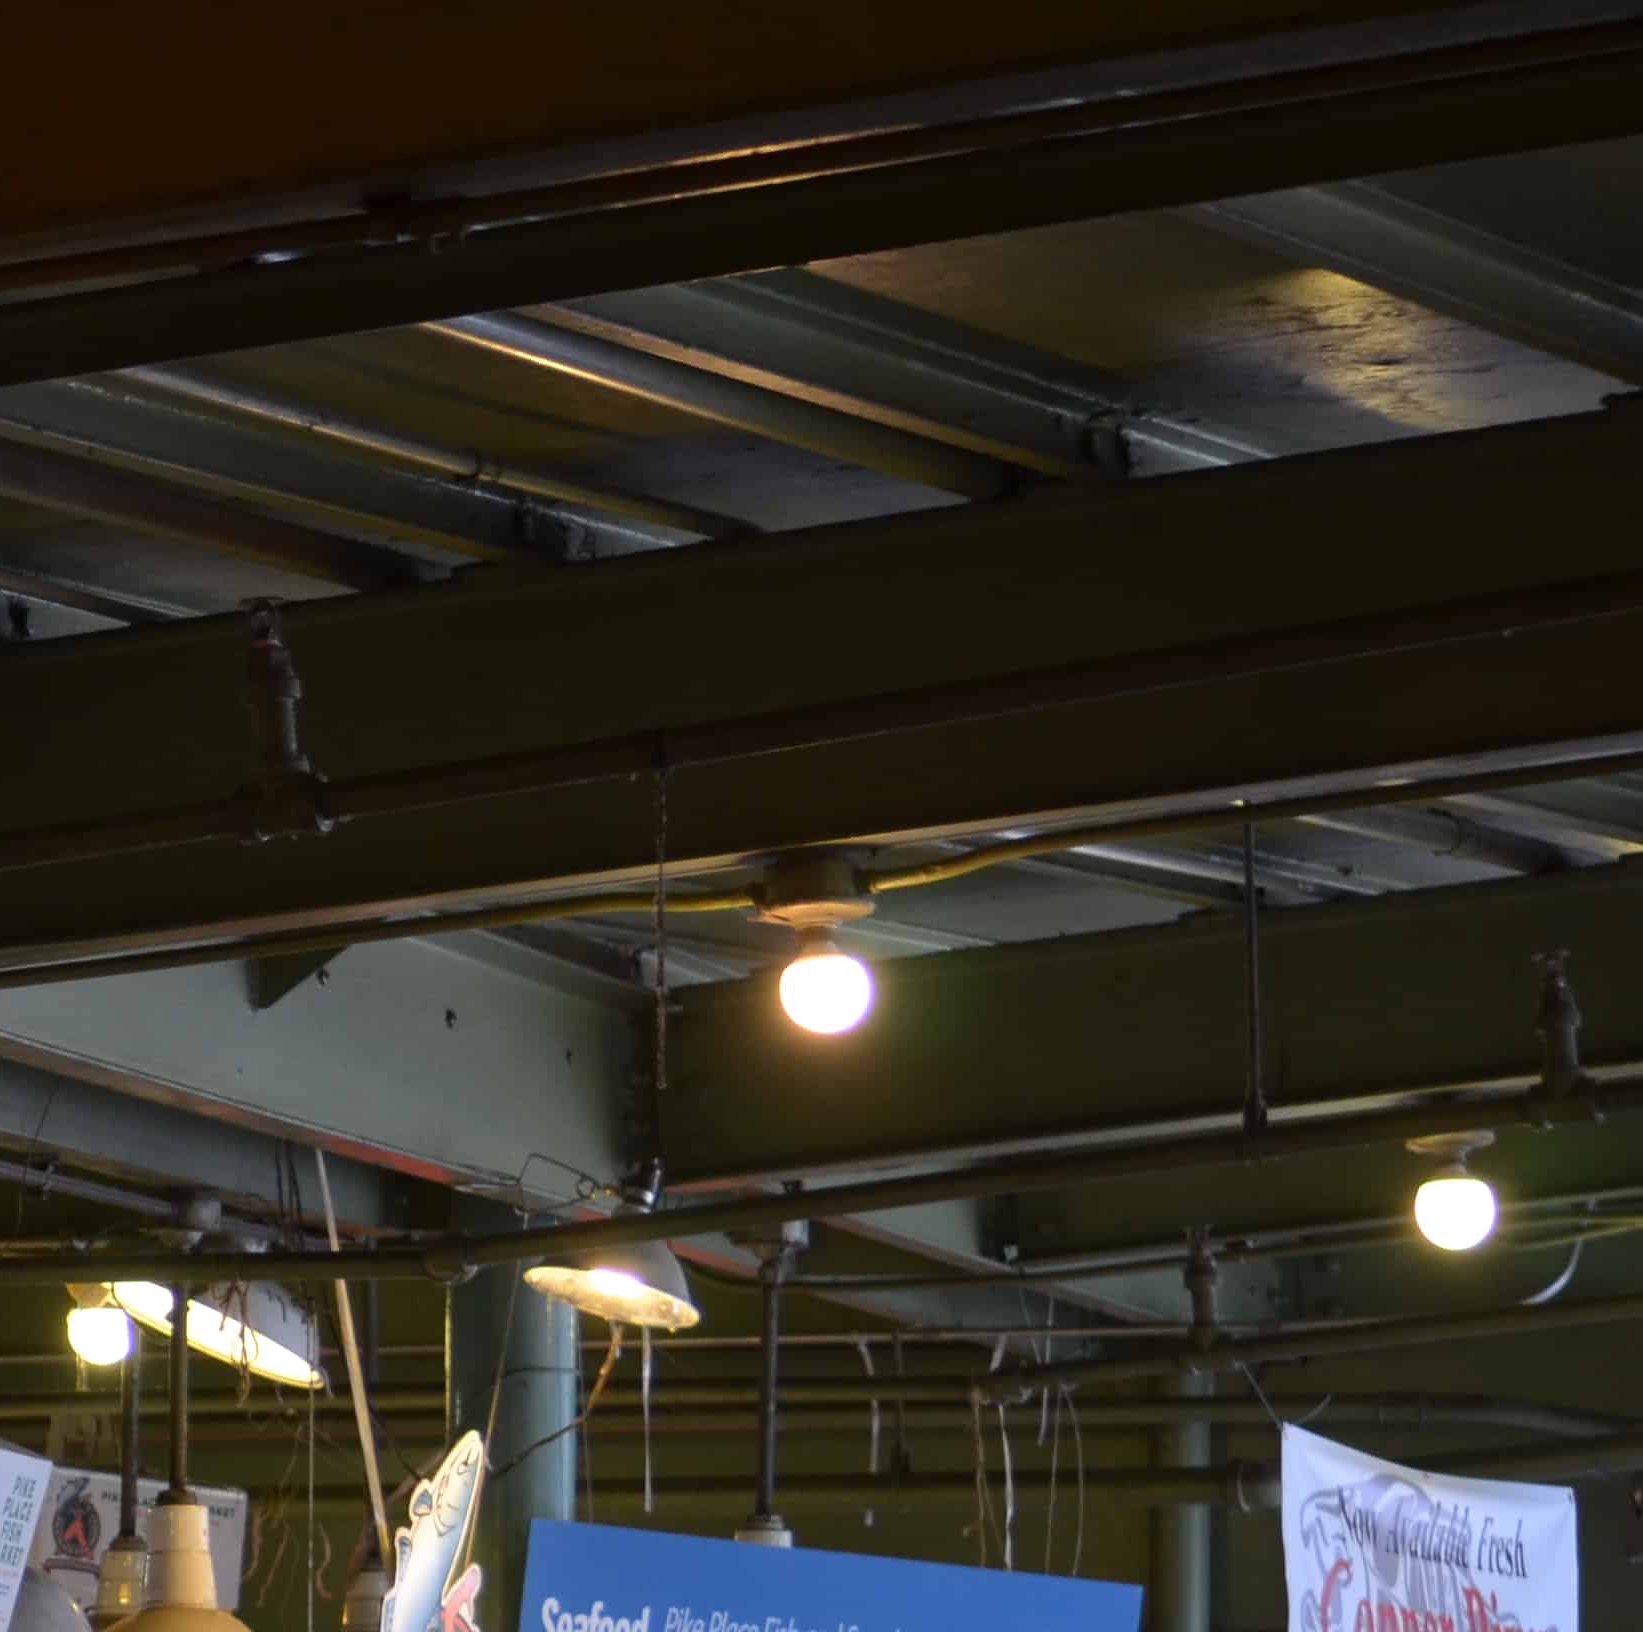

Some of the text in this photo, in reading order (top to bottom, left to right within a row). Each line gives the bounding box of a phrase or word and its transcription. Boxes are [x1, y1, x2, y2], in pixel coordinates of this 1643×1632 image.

[12, 1475, 37, 1498] PIKE
[2, 1497, 35, 1522] PLACE
[1476, 1514, 1527, 1578] Fresh
